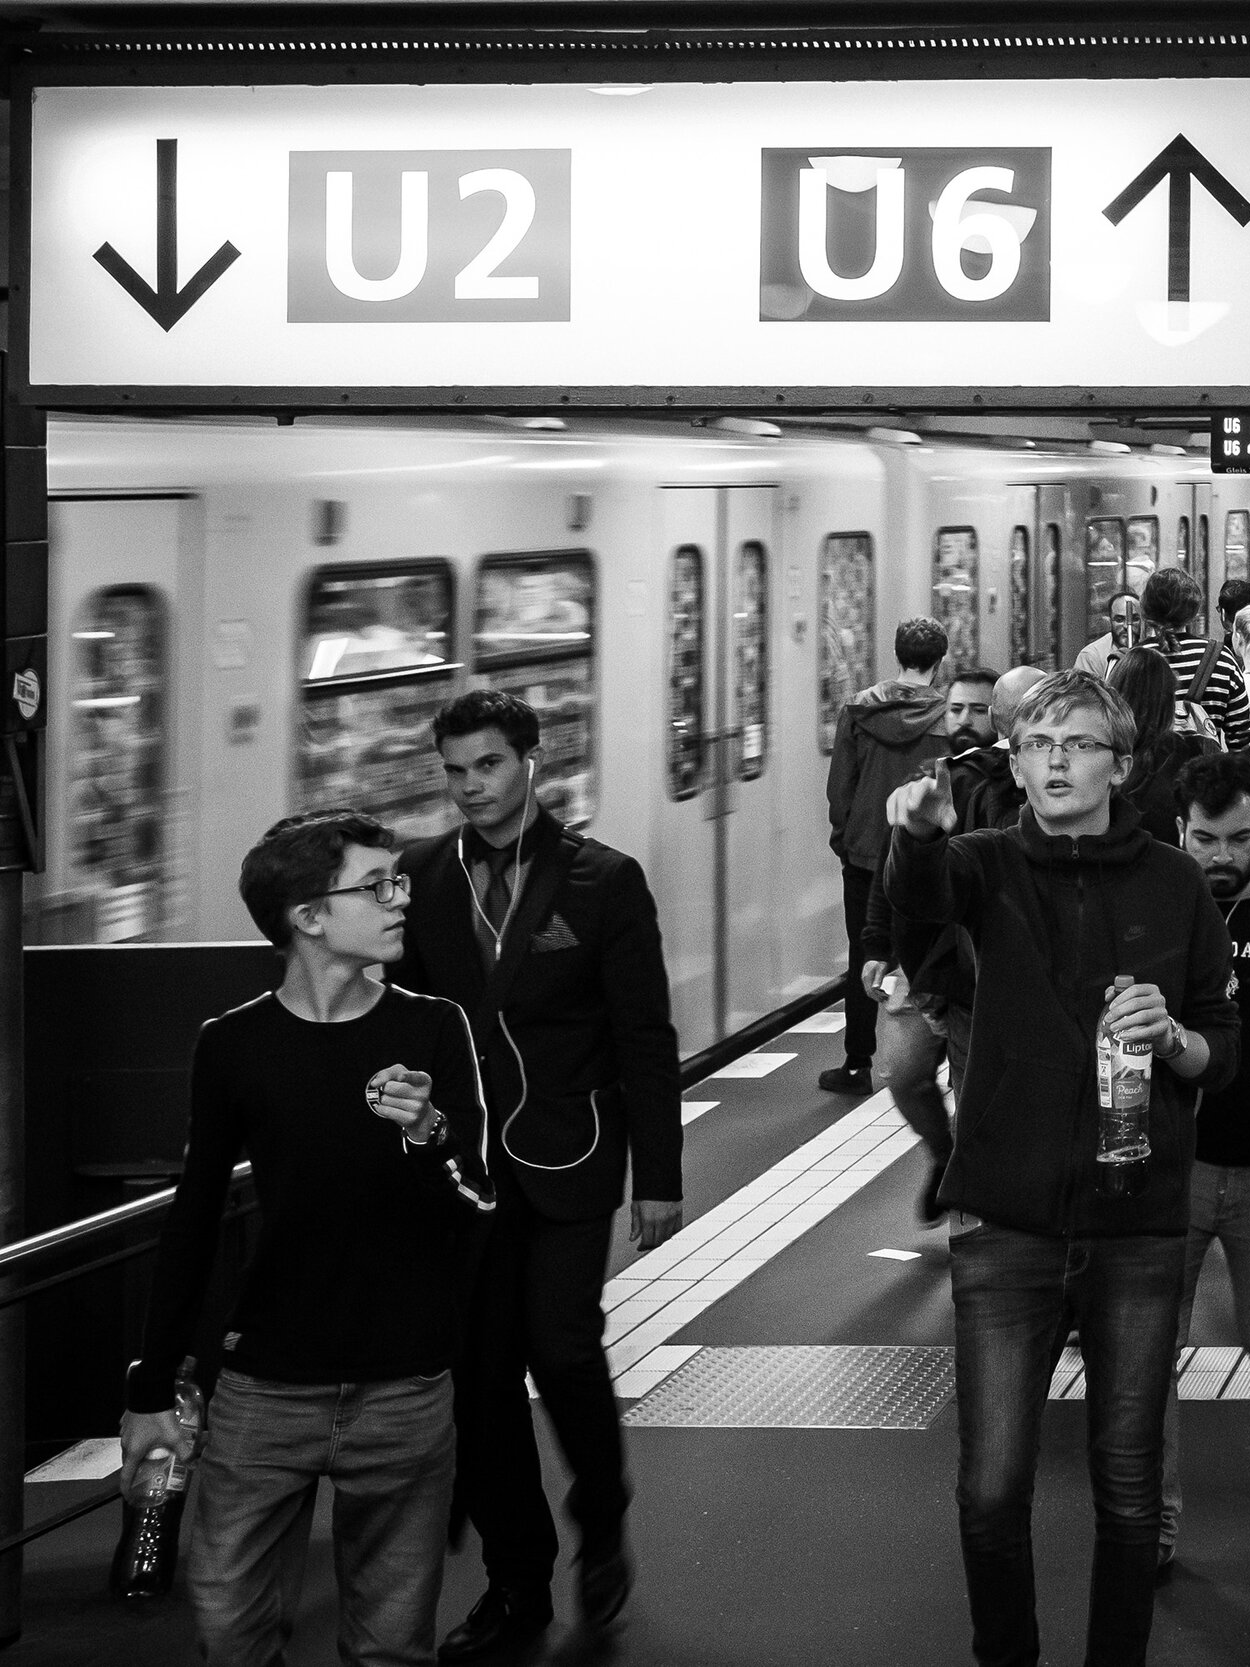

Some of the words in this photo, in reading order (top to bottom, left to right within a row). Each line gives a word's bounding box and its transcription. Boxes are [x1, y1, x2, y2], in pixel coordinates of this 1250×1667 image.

[323, 167, 541, 302] U2
[798, 165, 1023, 302] U6
[1223, 417, 1241, 434] U6
[1223, 439, 1241, 456] U6
[1116, 1082, 1143, 1095] Peach
